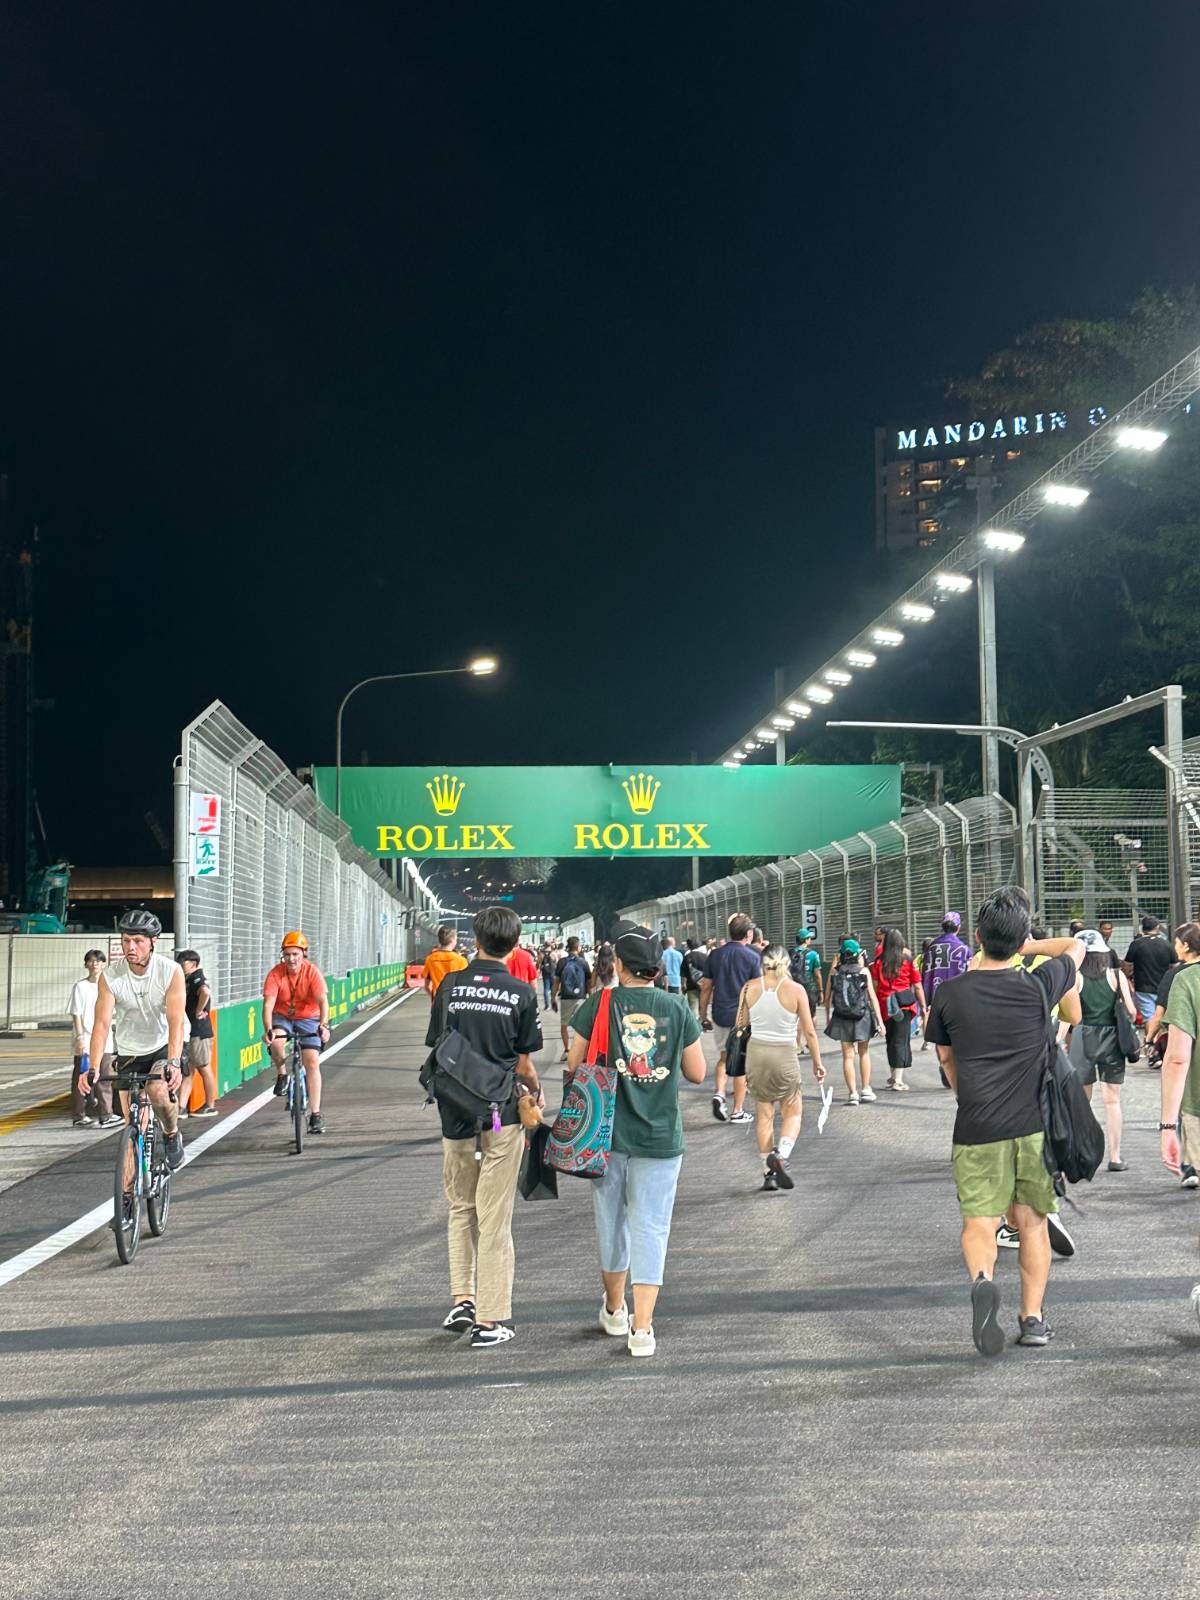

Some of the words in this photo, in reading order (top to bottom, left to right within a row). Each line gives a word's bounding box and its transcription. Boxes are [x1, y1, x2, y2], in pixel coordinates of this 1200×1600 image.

[897, 411, 1068, 450] MANDARIN
[376, 824, 515, 851] ROLEX
[573, 823, 711, 850] ROLEX
[451, 985, 520, 1005] ETRONAS
[448, 1002, 513, 1016] CROWDSTRIKE
